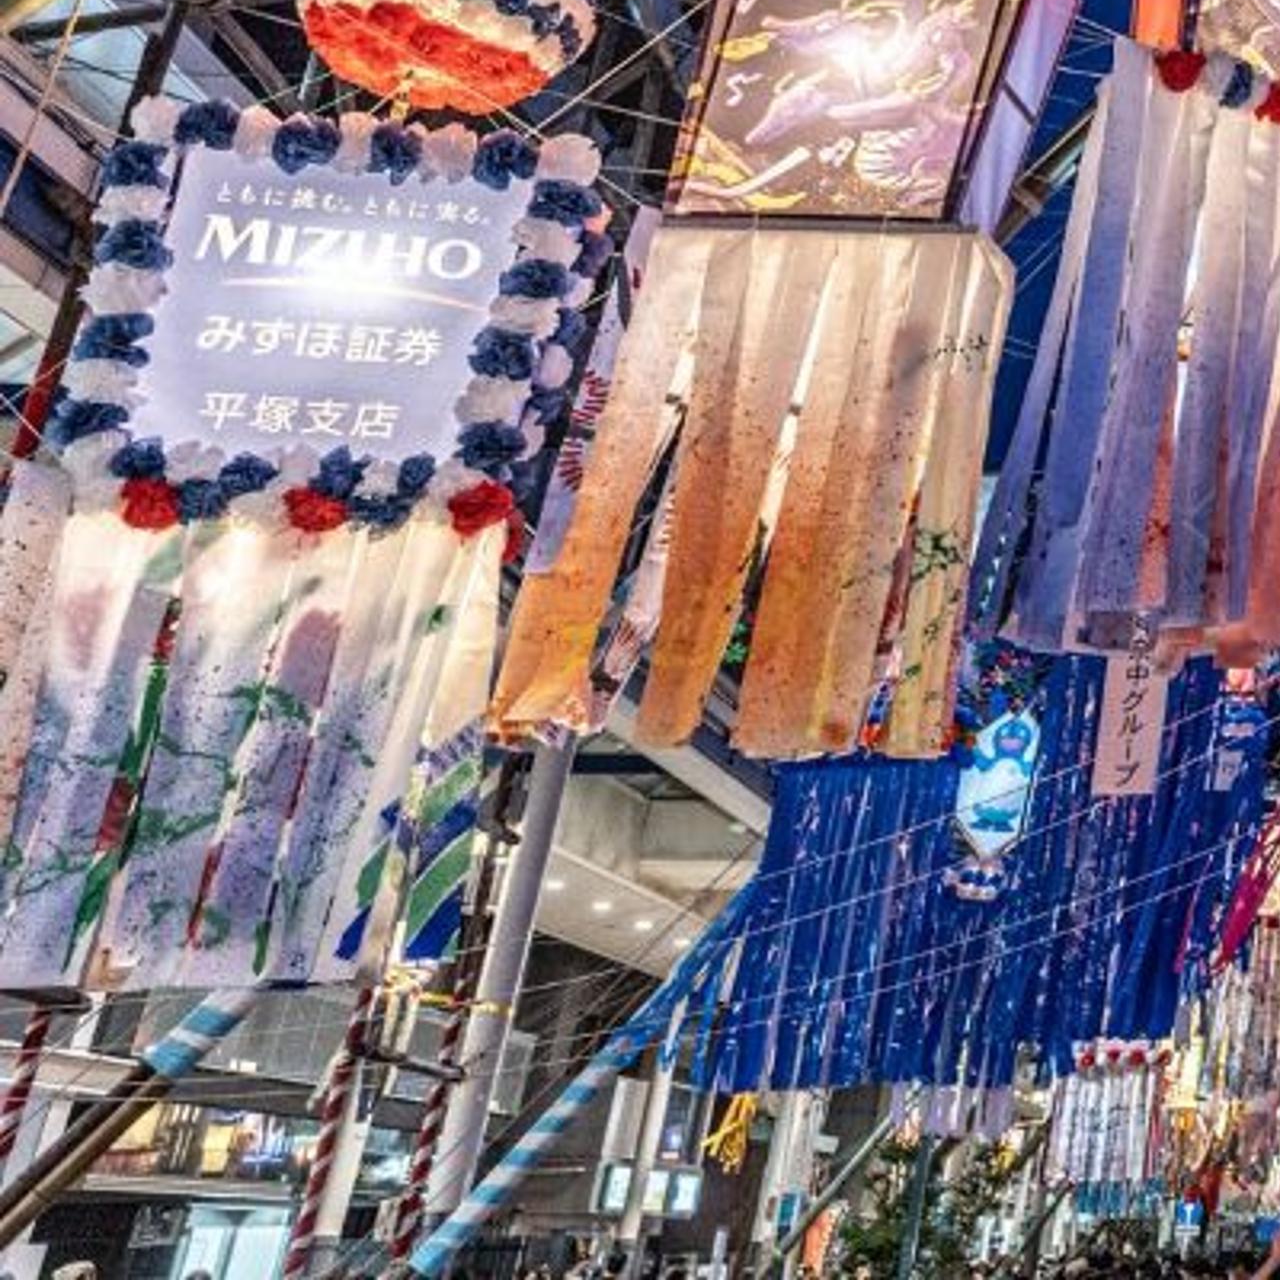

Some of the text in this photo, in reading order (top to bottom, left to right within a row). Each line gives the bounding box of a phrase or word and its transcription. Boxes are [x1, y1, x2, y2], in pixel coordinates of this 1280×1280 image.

[194, 213, 482, 282] MIZUHO
[196, 314, 444, 366] みずほ証券
[199, 391, 402, 439] 平塚支店
